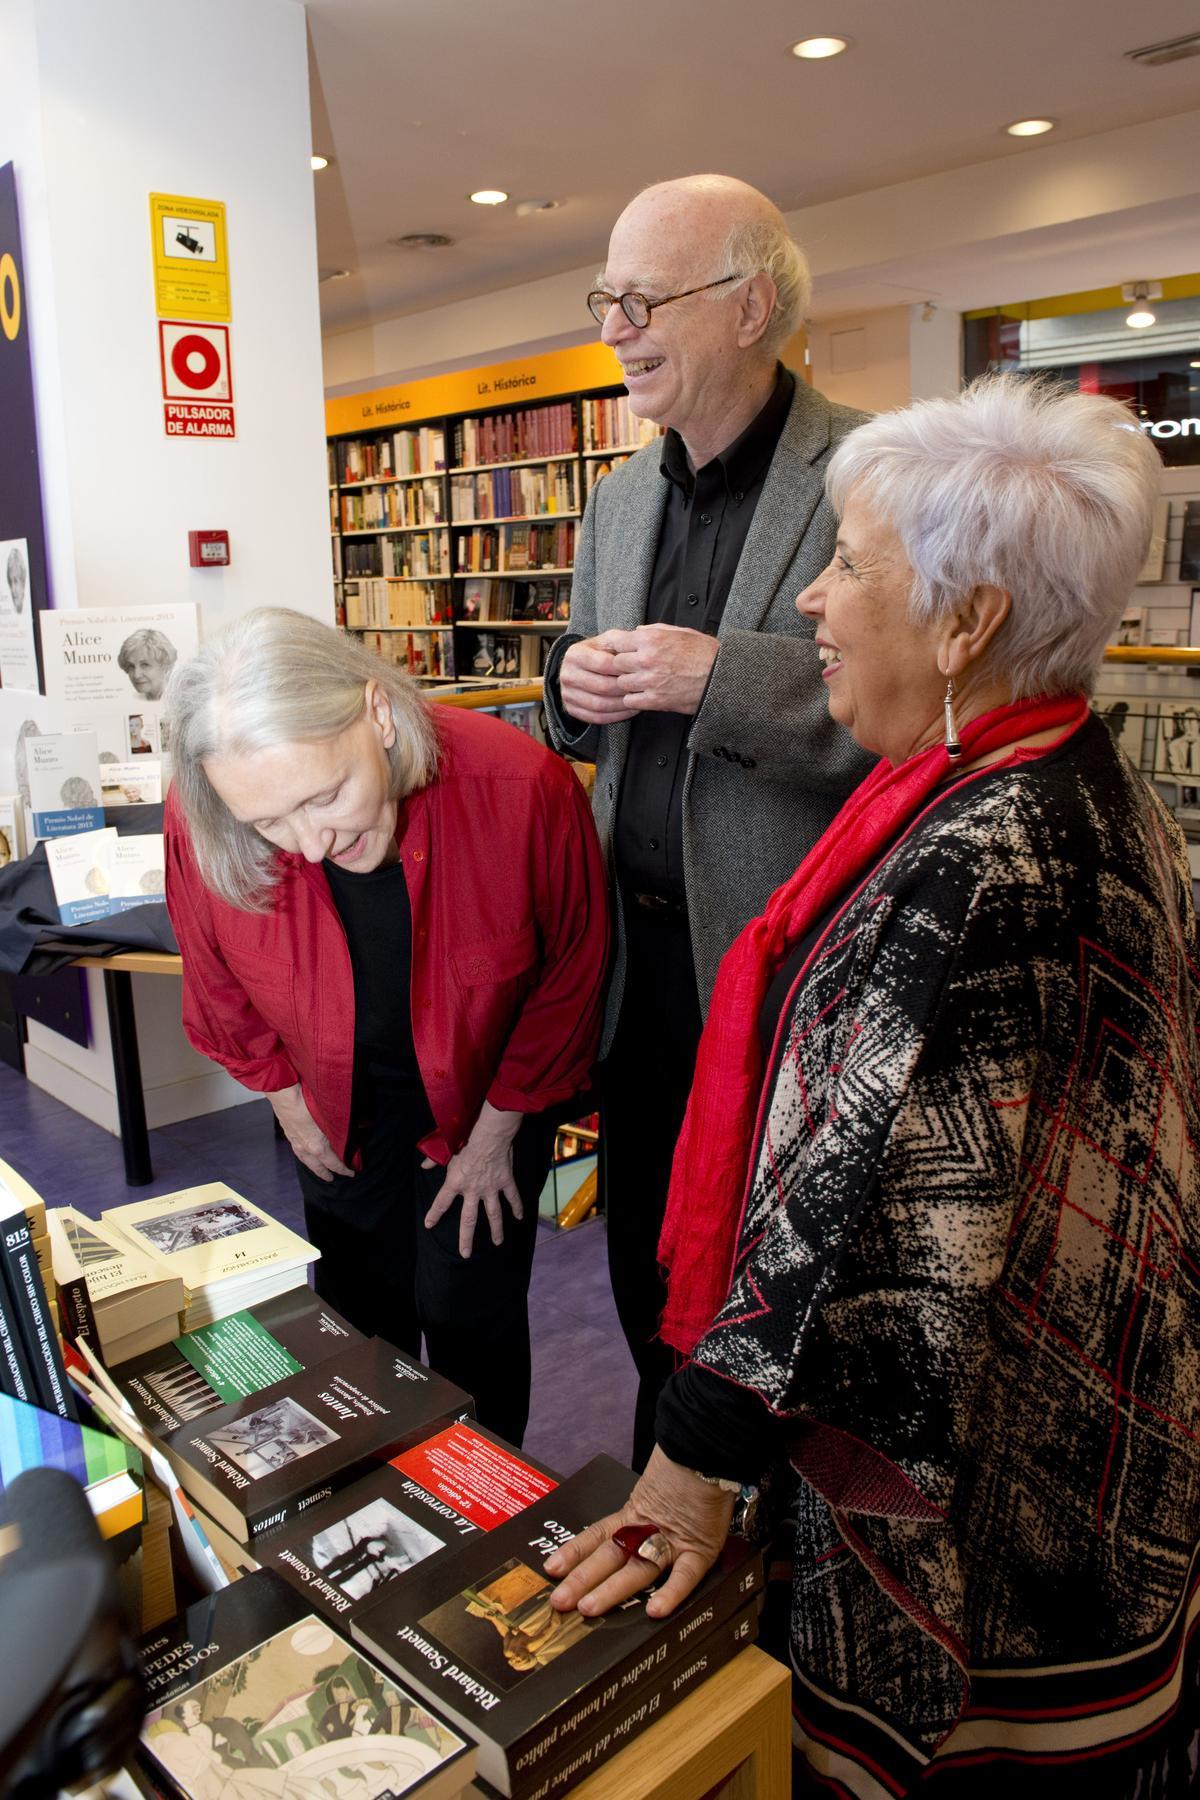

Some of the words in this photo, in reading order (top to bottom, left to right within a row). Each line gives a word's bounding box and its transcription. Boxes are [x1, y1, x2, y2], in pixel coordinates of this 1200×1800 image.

[477, 381, 491, 395] Lit.
[493, 374, 536, 392] Histórica
[168, 406, 232, 421] PULSADOR
[362, 406, 374, 417] Lit.
[375, 399, 411, 415] Histórica
[167, 421, 185, 434] DE
[186, 422, 234, 436] ALARMA
[62, 631, 103, 647] Alice
[63, 650, 112, 665] Munro
[33, 747, 53, 756] Alice
[33, 755, 59, 764] Munro
[44, 816, 66, 825] Premio
[66, 814, 86, 824] Nobel
[86, 814, 94, 823] de
[46, 822, 76, 832] Literatura
[77, 821, 94, 831] 2013
[70, 904, 94, 913] Premio
[5, 1227, 29, 1248] 815
[234, 1251, 247, 1260] 14
[18, 1254, 32, 1283] COLOR
[109, 1269, 123, 1279] El
[25, 1283, 37, 1298] SIN
[28, 1297, 44, 1325] CHICO
[72, 1287, 87, 1323] respeto
[35, 1324, 48, 1341] DEL
[77, 1324, 90, 1336] El
[2, 1335, 14, 1352] DEL
[40, 1340, 66, 1403] PEREGRINACIÓN
[128, 1377, 153, 1406] Sennett
[57, 1402, 67, 1414] DE
[149, 1400, 181, 1432] Richard
[317, 1391, 358, 1420] Juntos
[188, 1437, 218, 1463] Sennett
[214, 1456, 251, 1490] Richard
[437, 1482, 462, 1501] edición
[454, 1483, 463, 1491] DE
[462, 1488, 482, 1504] EUROPA
[297, 1486, 332, 1511] Sennett
[401, 1480, 458, 1520] corrosión
[252, 1509, 287, 1534] Juntos
[455, 1515, 478, 1535] La
[528, 1536, 560, 1557] del
[278, 1549, 317, 1581] Sennett
[309, 1577, 353, 1613] Richard
[679, 1606, 714, 1643] Sennett
[396, 1625, 449, 1671] Sennett
[655, 1642, 668, 1664] El
[621, 1656, 656, 1688] declive
[672, 1655, 709, 1692] Sennett
[442, 1664, 502, 1712] Richard
[602, 1683, 619, 1708] del
[648, 1692, 661, 1714] El
[560, 1697, 601, 1738] hombre
[613, 1705, 649, 1739] declive
[516, 1726, 558, 1772] público
[594, 1732, 611, 1758] del
[551, 1746, 593, 1789] hombre
